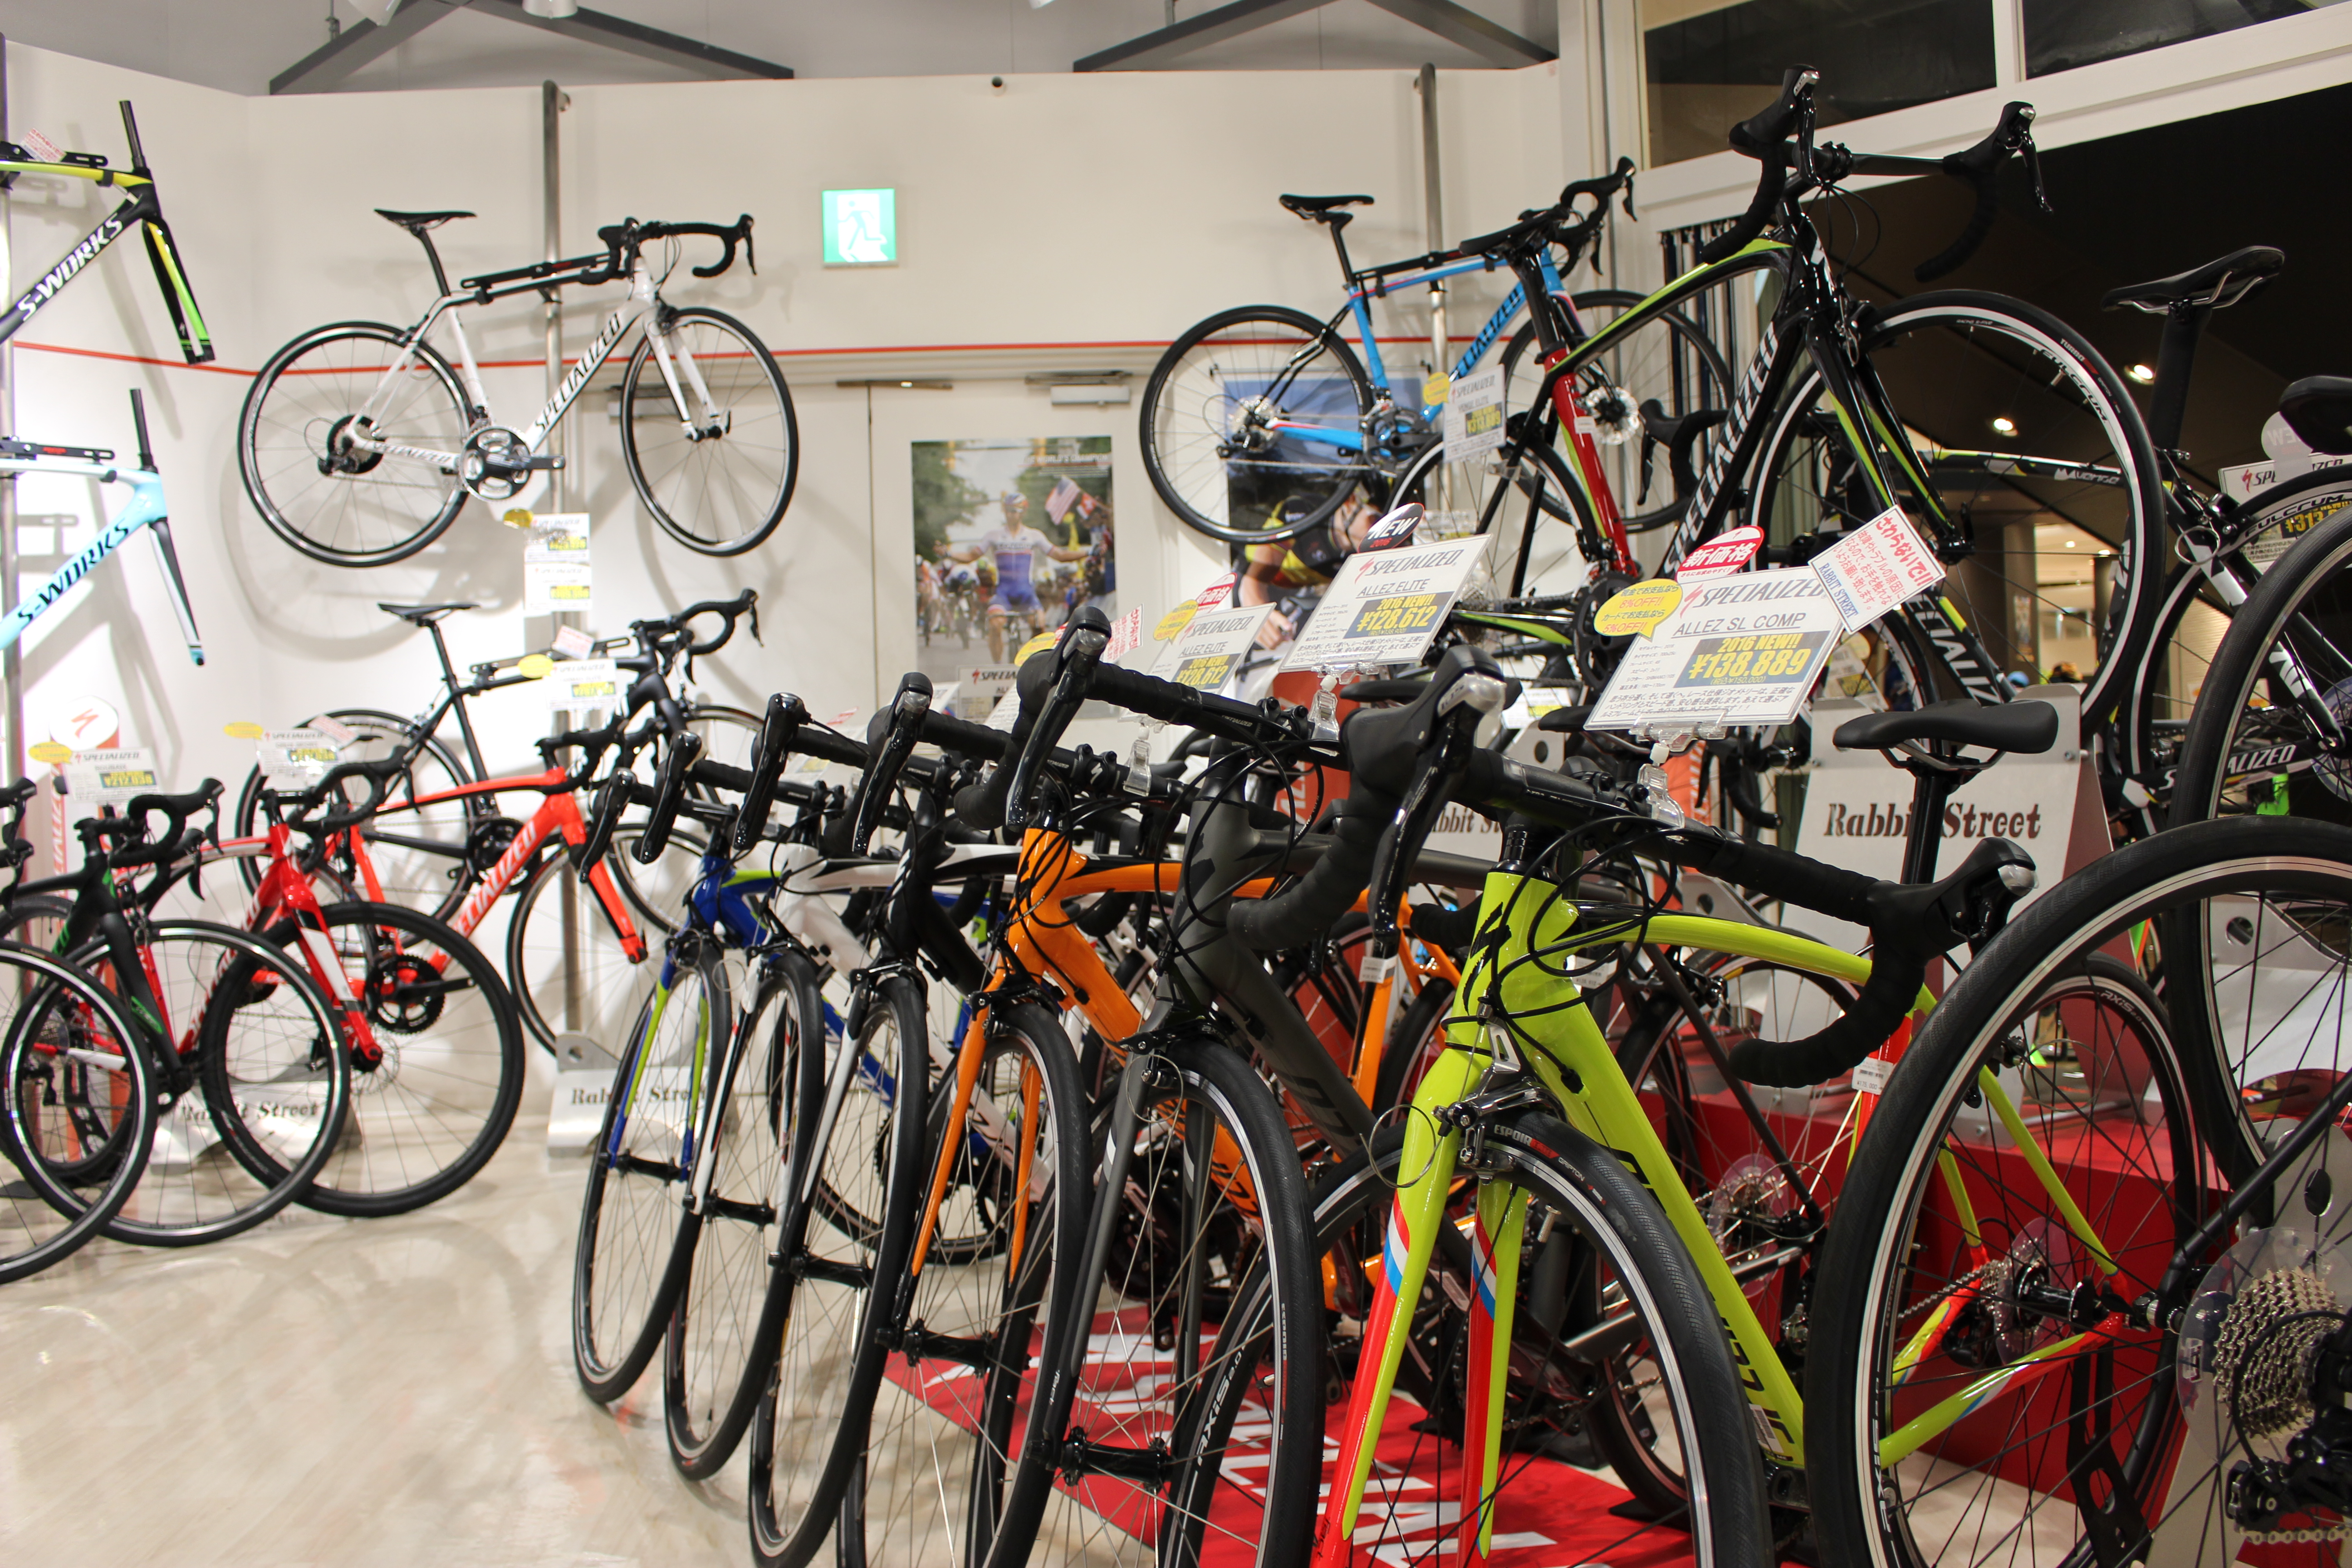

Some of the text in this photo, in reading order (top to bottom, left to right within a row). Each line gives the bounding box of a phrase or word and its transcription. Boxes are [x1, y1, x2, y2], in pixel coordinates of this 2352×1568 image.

[18, 214, 123, 321] S-WORKS
[2059, 338, 2085, 362] TURBO
[534, 313, 622, 435] SPECIALIZED
[2042, 348, 2107, 423] FULCRUM
[1664, 321, 1779, 574] SPECIALIZED
[1368, 515, 1419, 540] NEW
[1370, 549, 1465, 577] SPECIALIZED
[1682, 543, 1757, 568] 新価格
[18, 519, 130, 626] S-WORKS
[1358, 578, 1431, 597] ALLEZ ELITE
[1693, 578, 1827, 608] SPECIALIZED
[1818, 562, 1842, 590] RABBIT
[1833, 588, 1859, 618] STREET
[1377, 593, 1437, 611] 2016 NEW!!
[1187, 616, 1255, 638] SPECIALIZED
[1357, 605, 1438, 632] ¥128.612
[1674, 612, 1807, 636] ALLEZ SL COMP
[1181, 641, 1228, 656] ALLEZ ELITE
[1717, 633, 1804, 653] 2016 NEW!!
[1688, 648, 1811, 679] ¥138.889
[1432, 807, 1475, 833] bbit
[1823, 802, 2042, 838] Rabbi Street
[1494, 1124, 1533, 1145] ESPOIR
